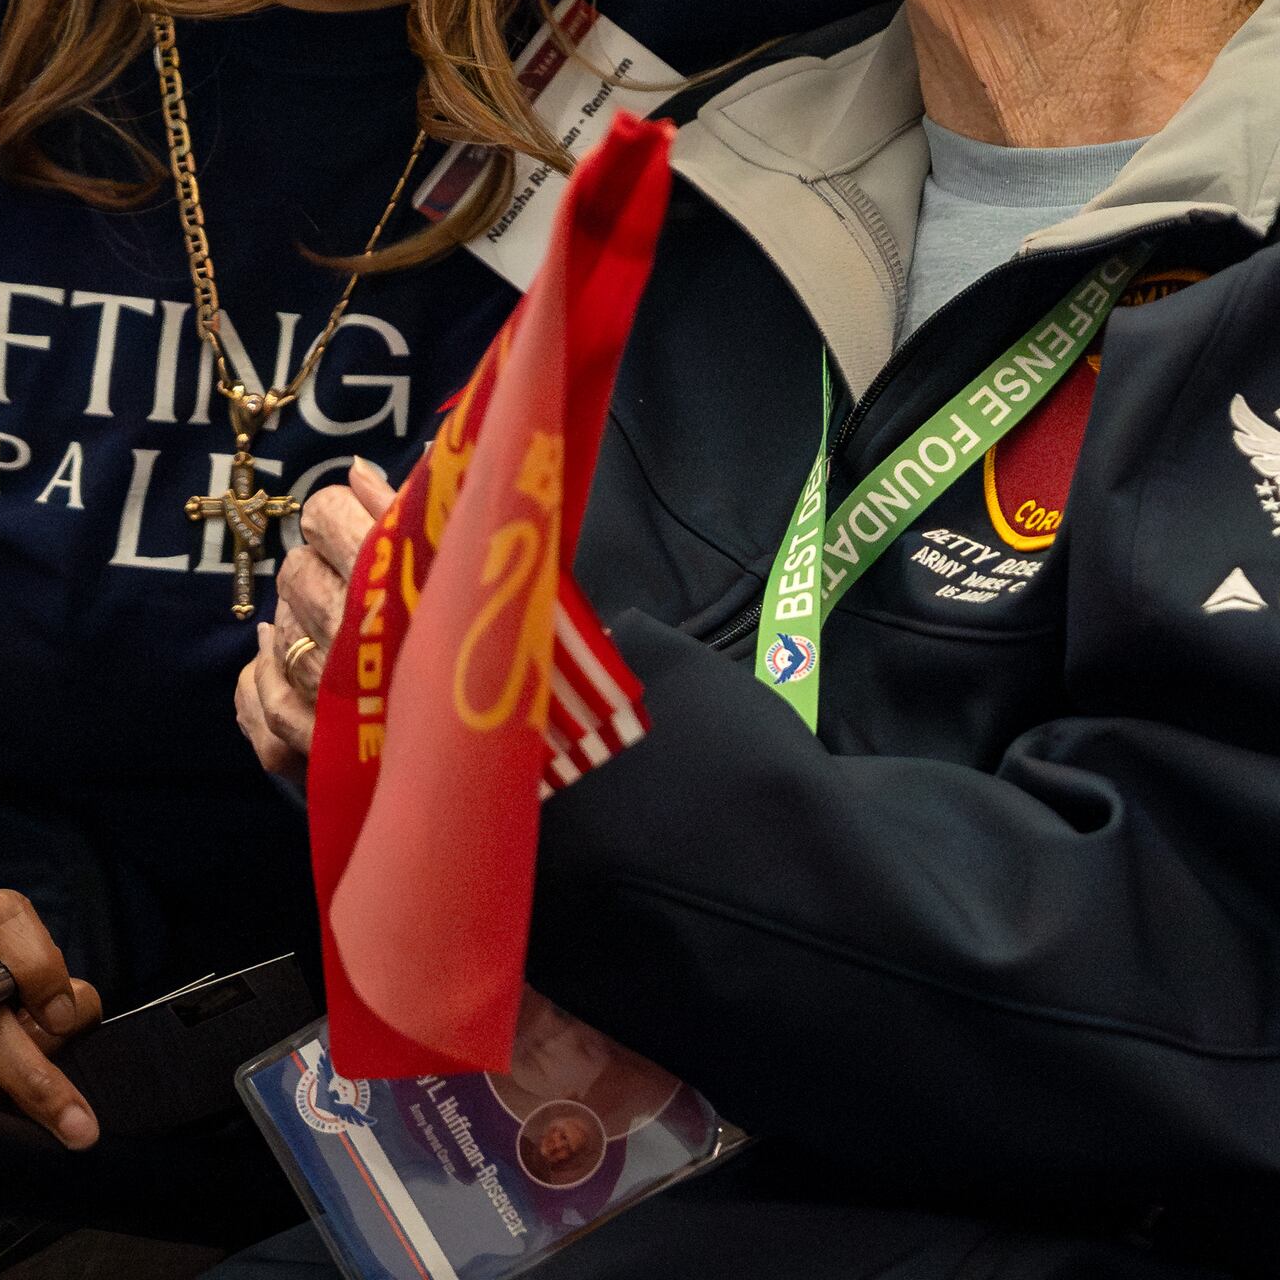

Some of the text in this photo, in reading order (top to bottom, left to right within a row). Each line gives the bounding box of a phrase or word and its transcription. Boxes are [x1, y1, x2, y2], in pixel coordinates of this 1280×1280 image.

[486, 186, 535, 244] Natasha
[821, 256, 1127, 602] DEFENSE FOUNDAT
[35, 442, 85, 511] A
[775, 526, 821, 621] BEST
[910, 546, 967, 578] ARMY
[921, 528, 1000, 564] BETTY
